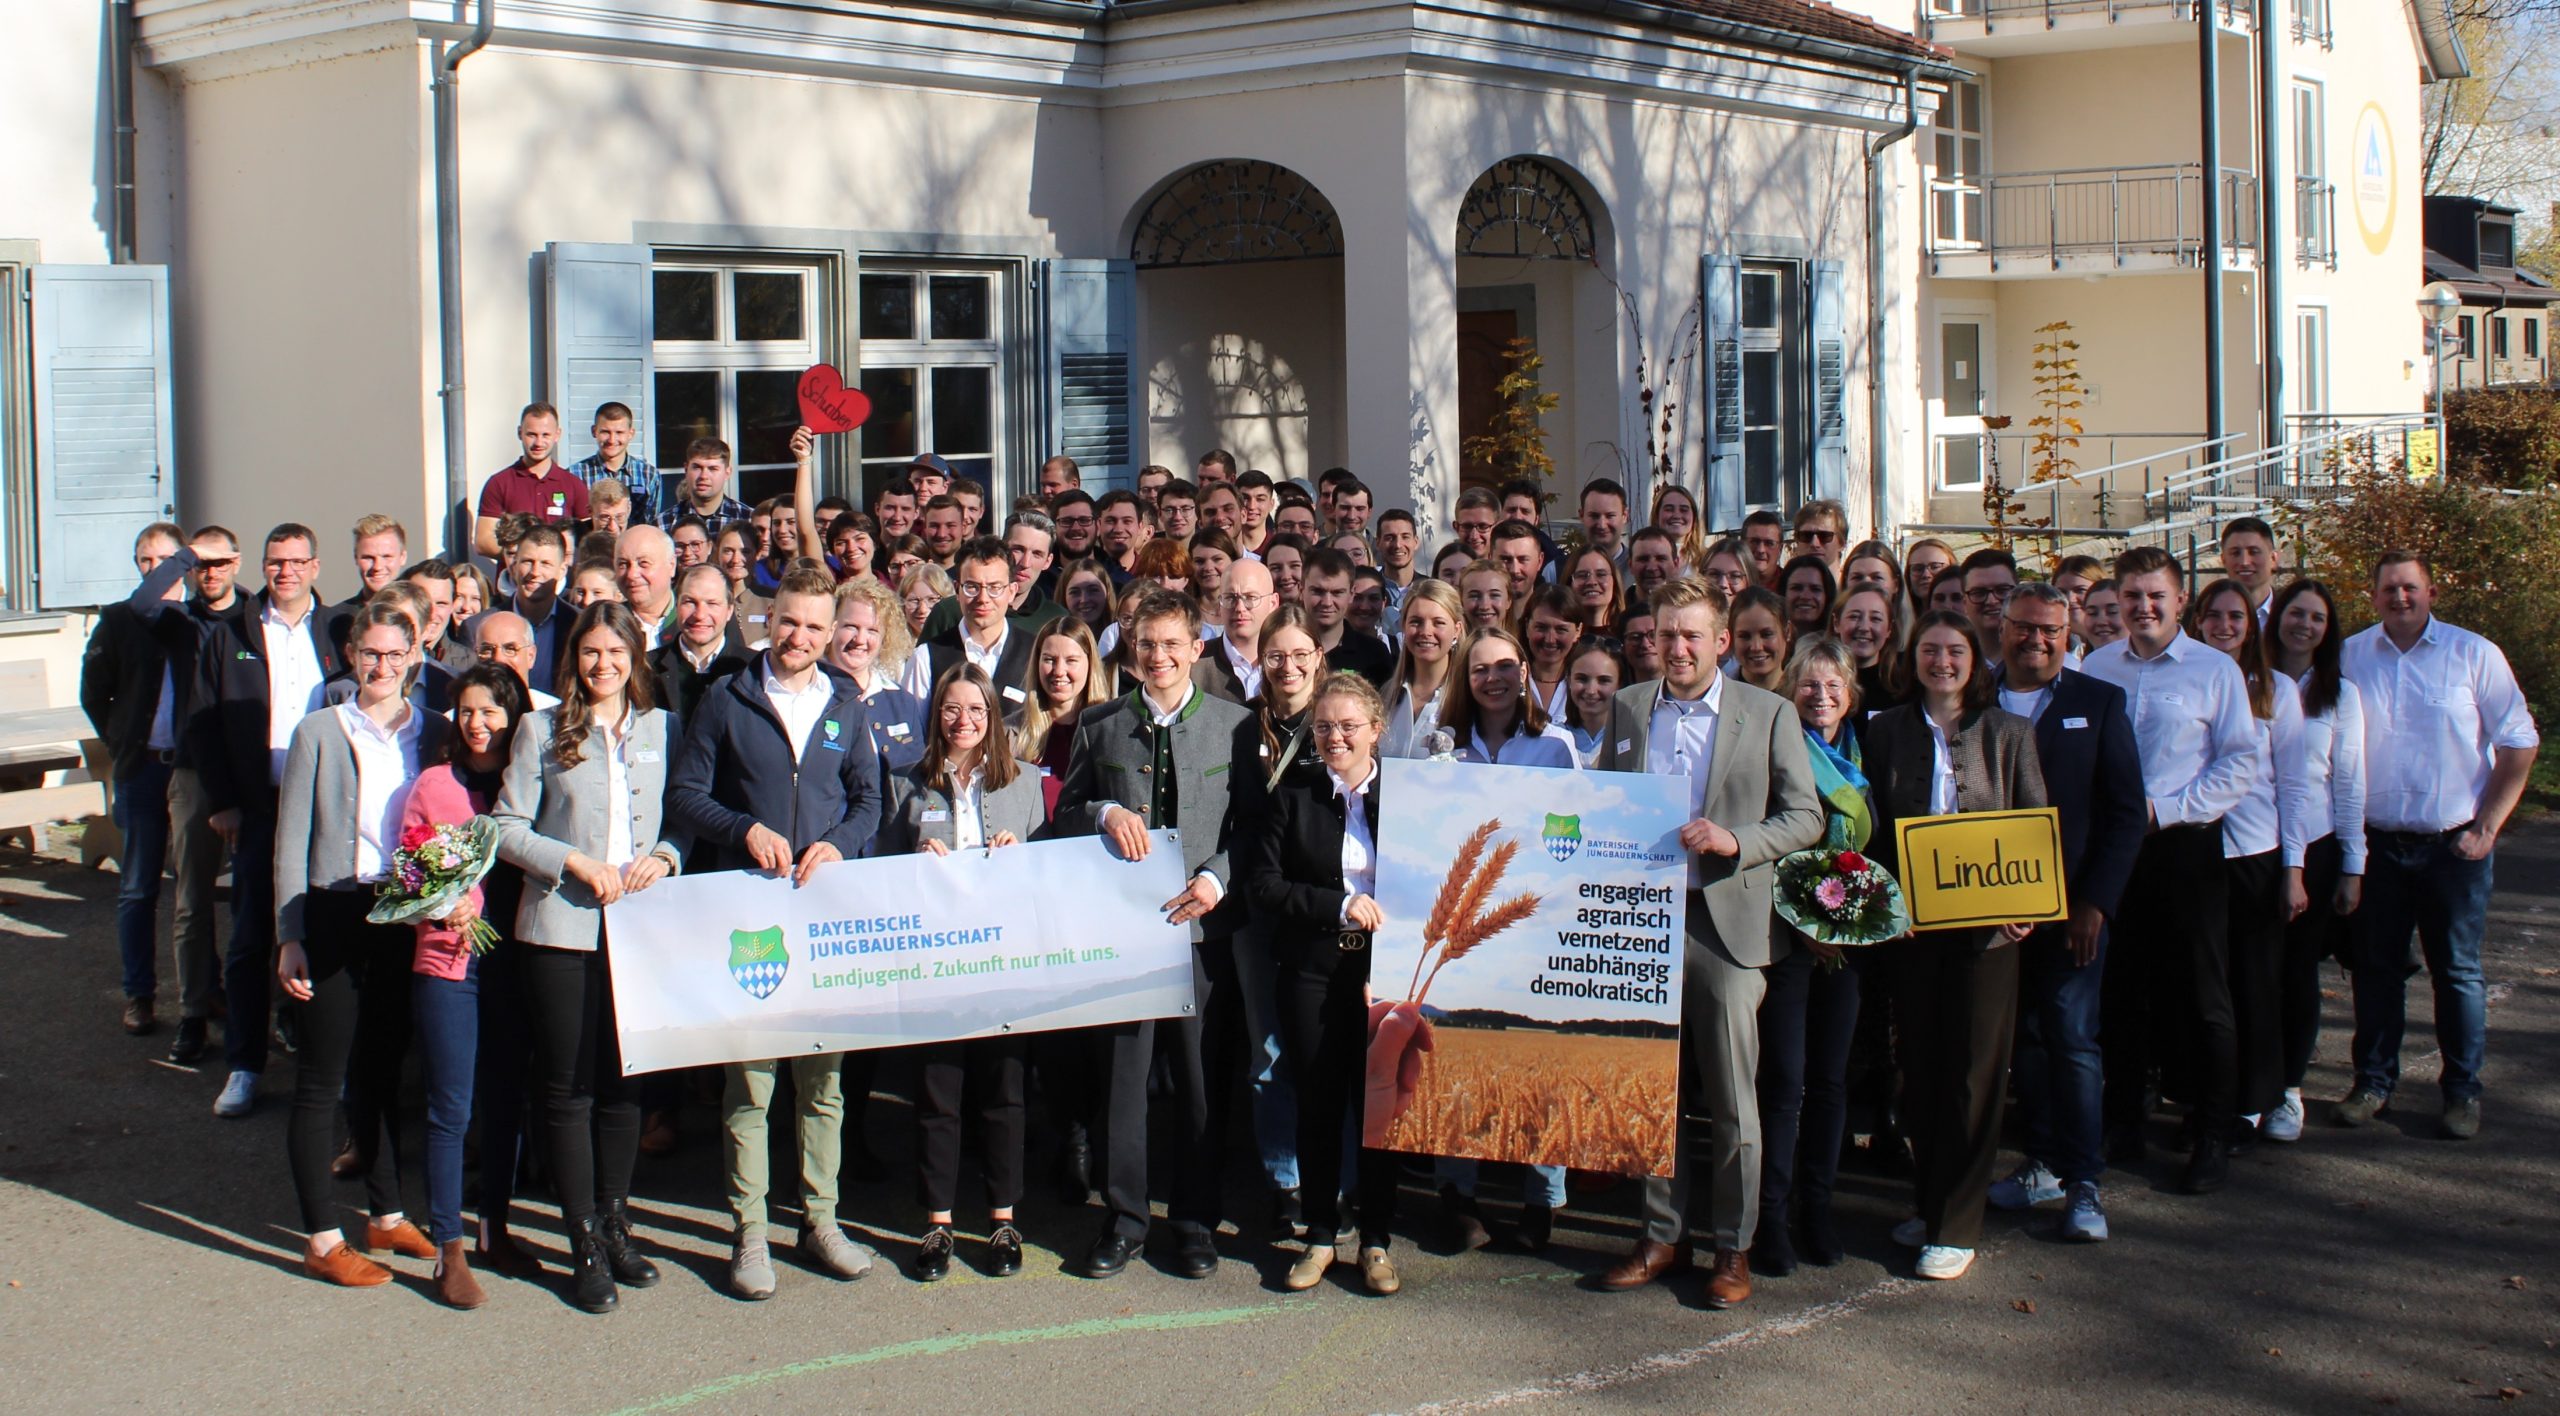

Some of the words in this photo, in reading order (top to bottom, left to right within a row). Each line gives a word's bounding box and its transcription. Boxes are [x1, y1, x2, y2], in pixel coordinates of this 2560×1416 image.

[1586, 849, 1675, 862] JUNGBAUERNSCHAFT
[1587, 840, 1639, 851] BAYERISCHE
[1933, 838, 2044, 891] Lindau
[1579, 882, 1673, 906] engagiert
[808, 914, 922, 938] BAYERISCHE
[1577, 906, 1671, 929] agrarisch
[810, 926, 1003, 961] JUNGBAUERNSCHAFT
[1558, 931, 1670, 954] vernetzend
[812, 963, 928, 989] Landjugend.
[933, 955, 1005, 978] Zukunft
[1010, 954, 1041, 970] nur
[1046, 947, 1076, 966] mit
[1081, 946, 1120, 962] uns.
[1548, 953, 1671, 984] unabhängig
[1530, 974, 1668, 1005] demokratisch
